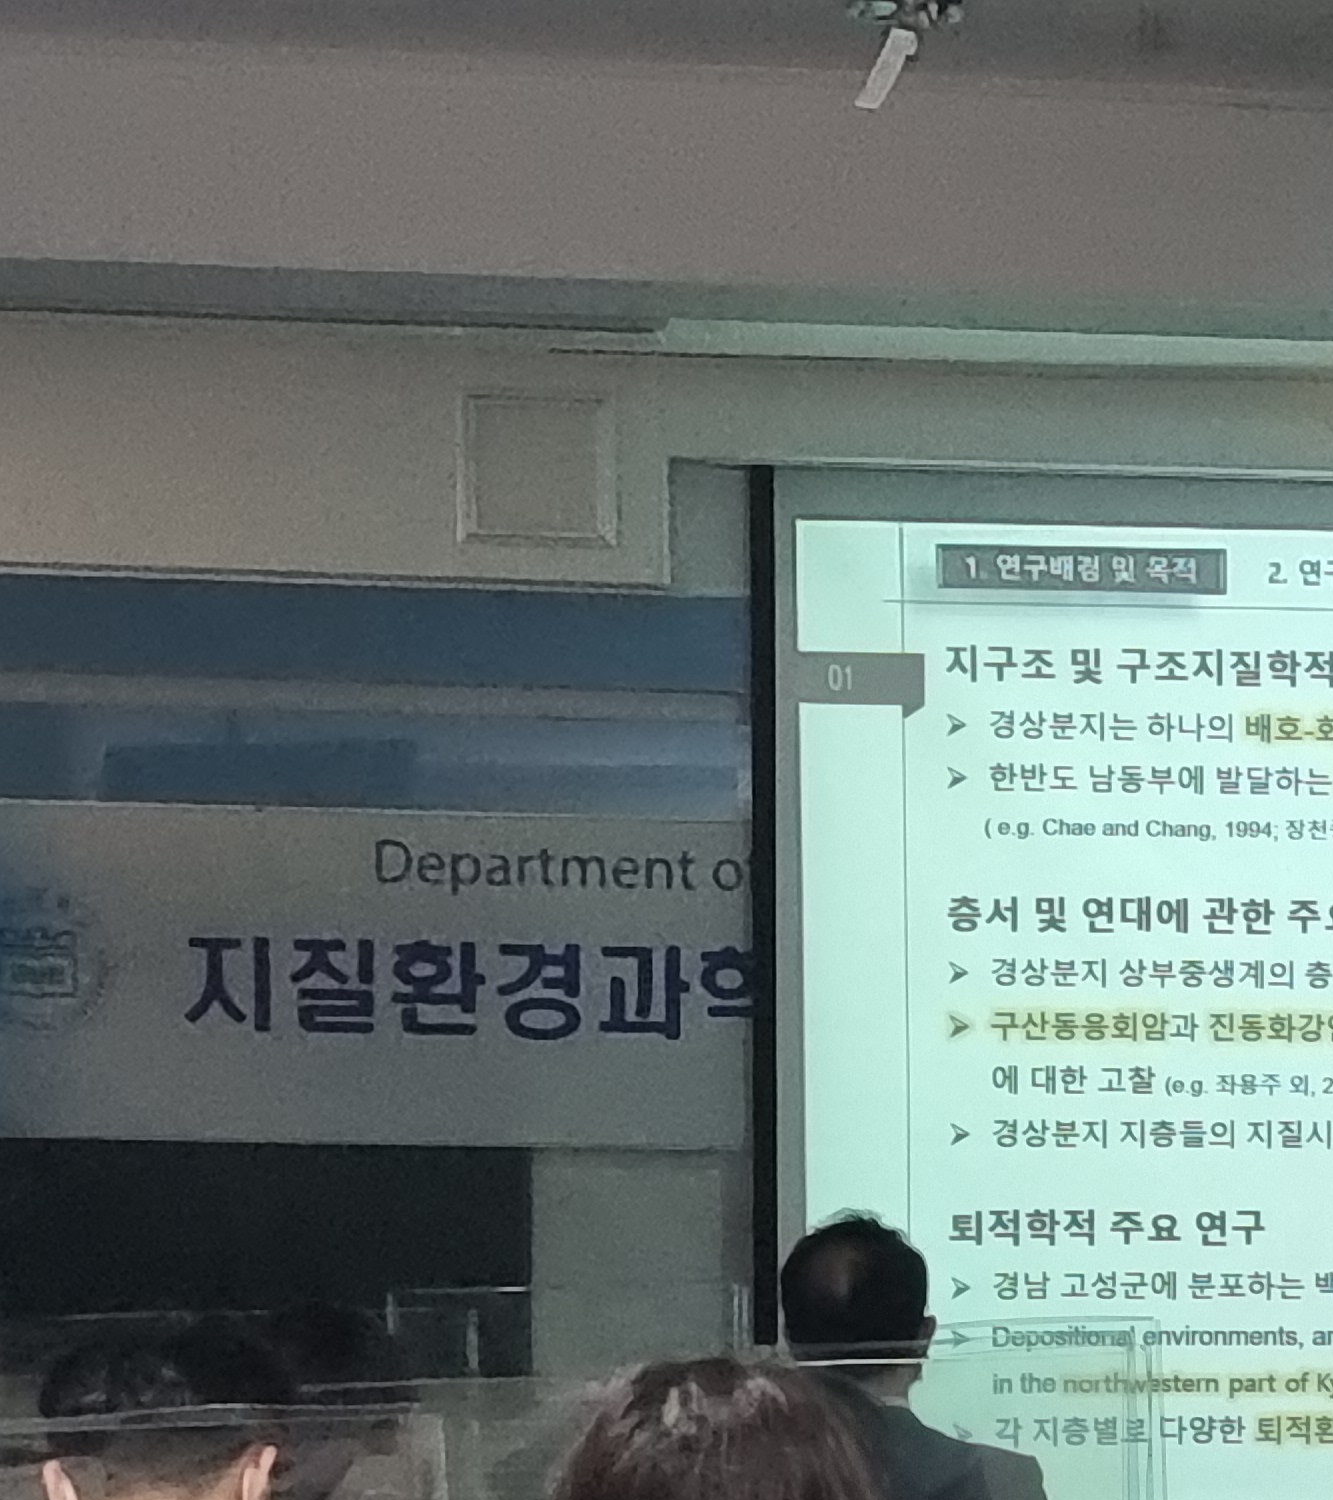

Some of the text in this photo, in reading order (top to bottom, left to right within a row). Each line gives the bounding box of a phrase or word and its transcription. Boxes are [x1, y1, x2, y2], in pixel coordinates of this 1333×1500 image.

[1113, 556, 1135, 583] 및
[1268, 562, 1288, 584] 2.
[829, 665, 852, 690] 01
[946, 644, 1056, 683] 지구조
[1071, 648, 1102, 684] 및
[990, 710, 1138, 741] 경상분지는
[1147, 712, 1233, 743] 하나의
[989, 763, 1078, 792] 한반도
[1090, 765, 1204, 795] 남동부에
[1217, 766, 1332, 796] 발달하는
[1042, 818, 1096, 836] Chae
[1102, 820, 1139, 837] and
[1146, 820, 1216, 841] Chang,
[1226, 821, 1278, 842] 1994;
[374, 839, 753, 895] Department o
[948, 896, 1018, 932] 층서
[1036, 896, 1067, 933] 및
[1082, 896, 1188, 934] 연대에
[1203, 897, 1275, 935] 관한
[992, 958, 1106, 988] 경상분지
[1119, 959, 1294, 989] 상부중생계의
[990, 1011, 1199, 1042] 구산동응회암과
[992, 1065, 1018, 1095] 에
[1031, 1065, 1088, 1095] 대한
[1098, 1066, 1156, 1094] 고찰
[1165, 1076, 1208, 1097] (e.g.
[993, 1119, 1107, 1149] 경상분지
[1120, 1119, 1234, 1149] 지층들의
[949, 1209, 1265, 1247] 퇴적학적 주요 연구
[993, 1271, 1050, 1300] 경남
[1061, 1271, 1176, 1300] 고성군에
[1188, 1271, 1305, 1301] 분포하는
[991, 1325, 1135, 1351] Depositional
[1143, 1325, 1304, 1349] environments,
[993, 1373, 1012, 1395] in
[1020, 1373, 1056, 1394] the
[1063, 1372, 1219, 1394] northwestern
[1229, 1374, 1277, 1399] part
[1285, 1372, 1310, 1392] of
[995, 1416, 1022, 1448] 각
[1033, 1415, 1150, 1446] 지층별로
[1160, 1415, 1246, 1446] 다양한
